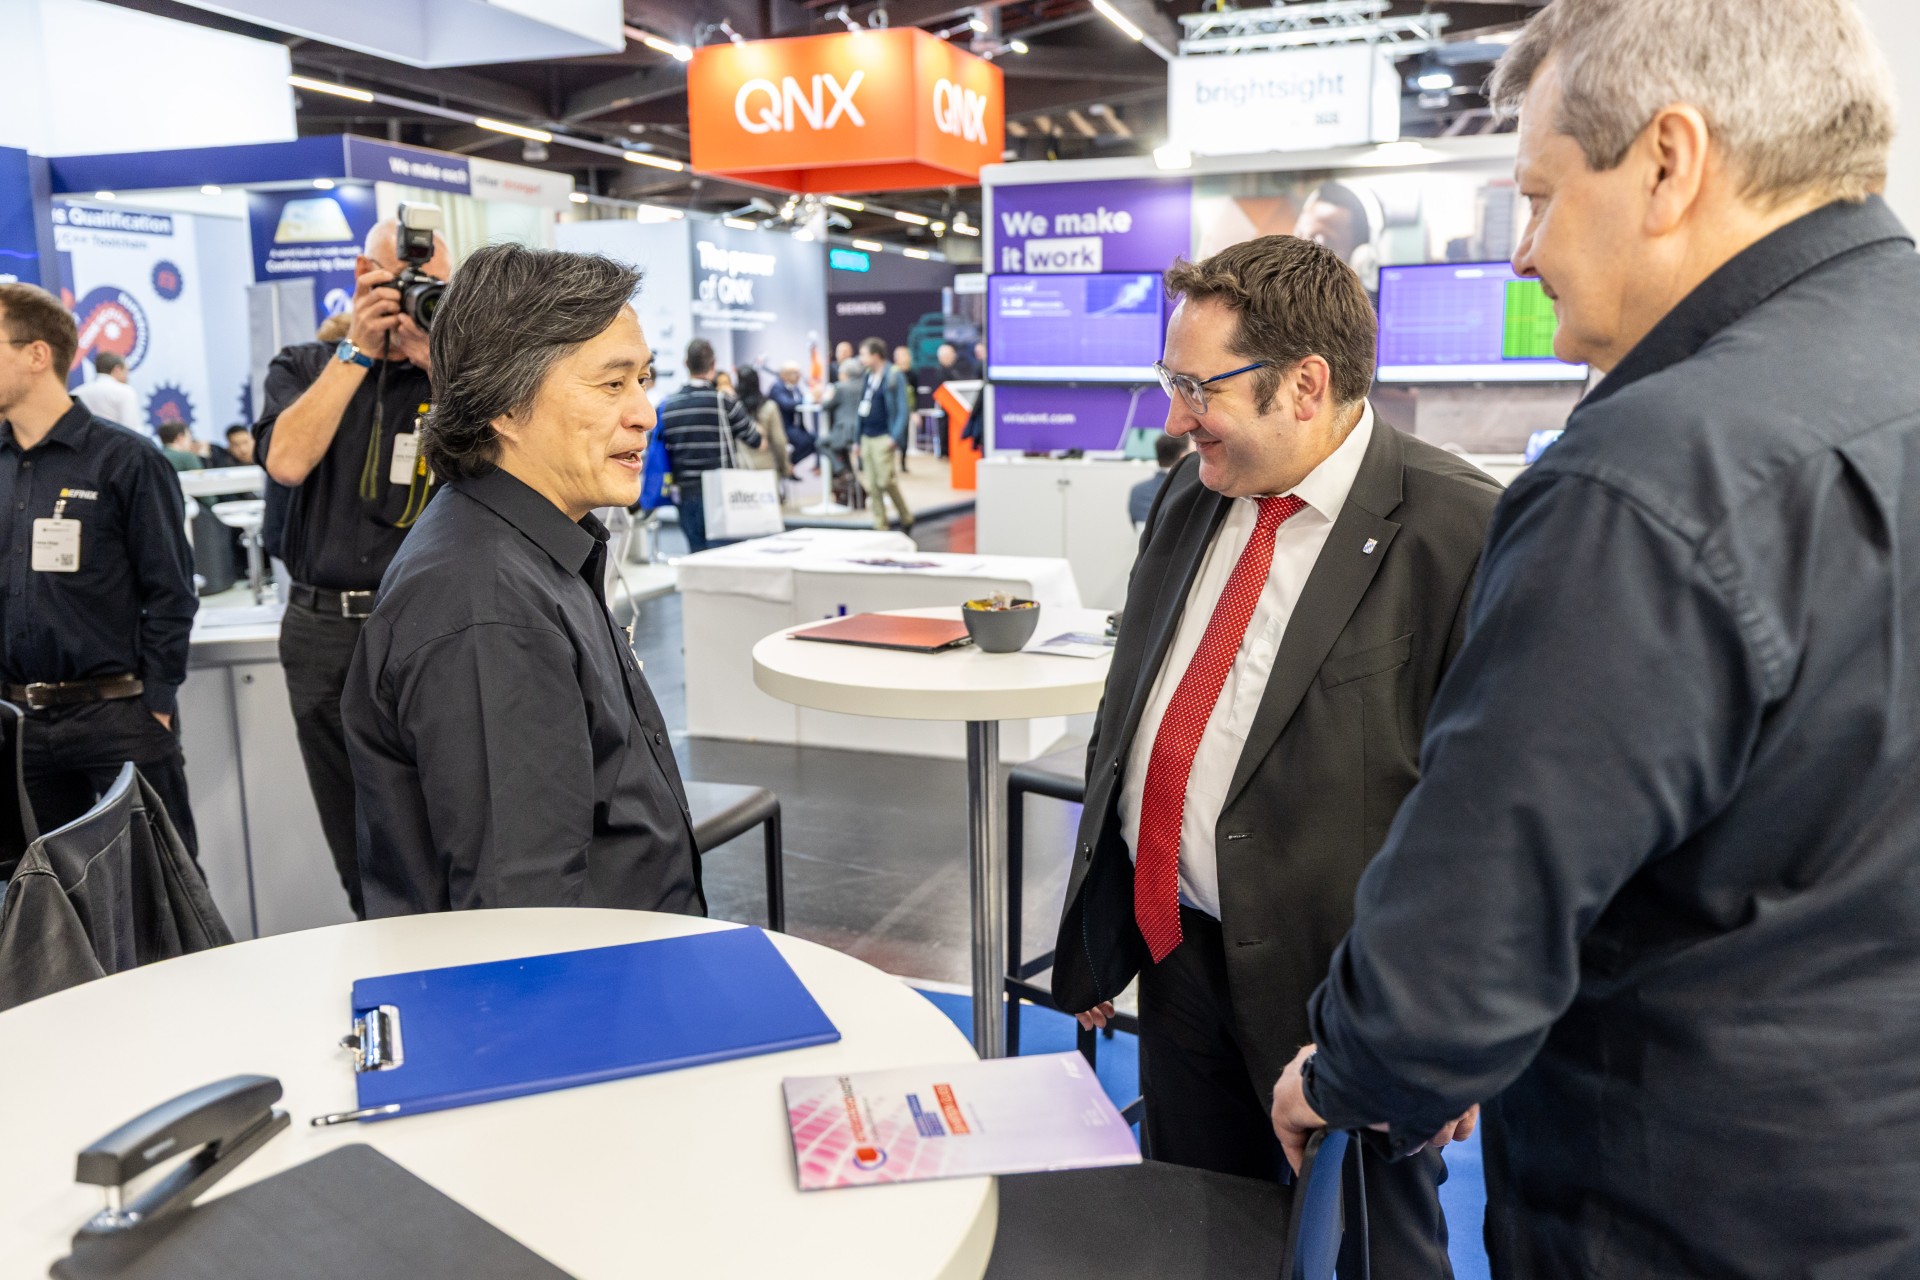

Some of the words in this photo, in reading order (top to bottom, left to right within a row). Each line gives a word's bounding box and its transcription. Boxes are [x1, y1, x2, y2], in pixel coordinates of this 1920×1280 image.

[734, 69, 866, 134] QNX
[1195, 73, 1344, 107] brightsight
[932, 77, 988, 145] QNX
[388, 155, 409, 176] We
[410, 161, 441, 181] make
[442, 166, 468, 185] each
[68, 205, 171, 233] Qualification
[1001, 211, 1048, 237] We
[1054, 206, 1133, 235] make
[696, 240, 728, 271] The
[728, 250, 776, 278] power
[1002, 246, 1023, 272] it
[1030, 245, 1095, 268] work
[699, 273, 718, 301] of
[717, 275, 754, 305] QNX
